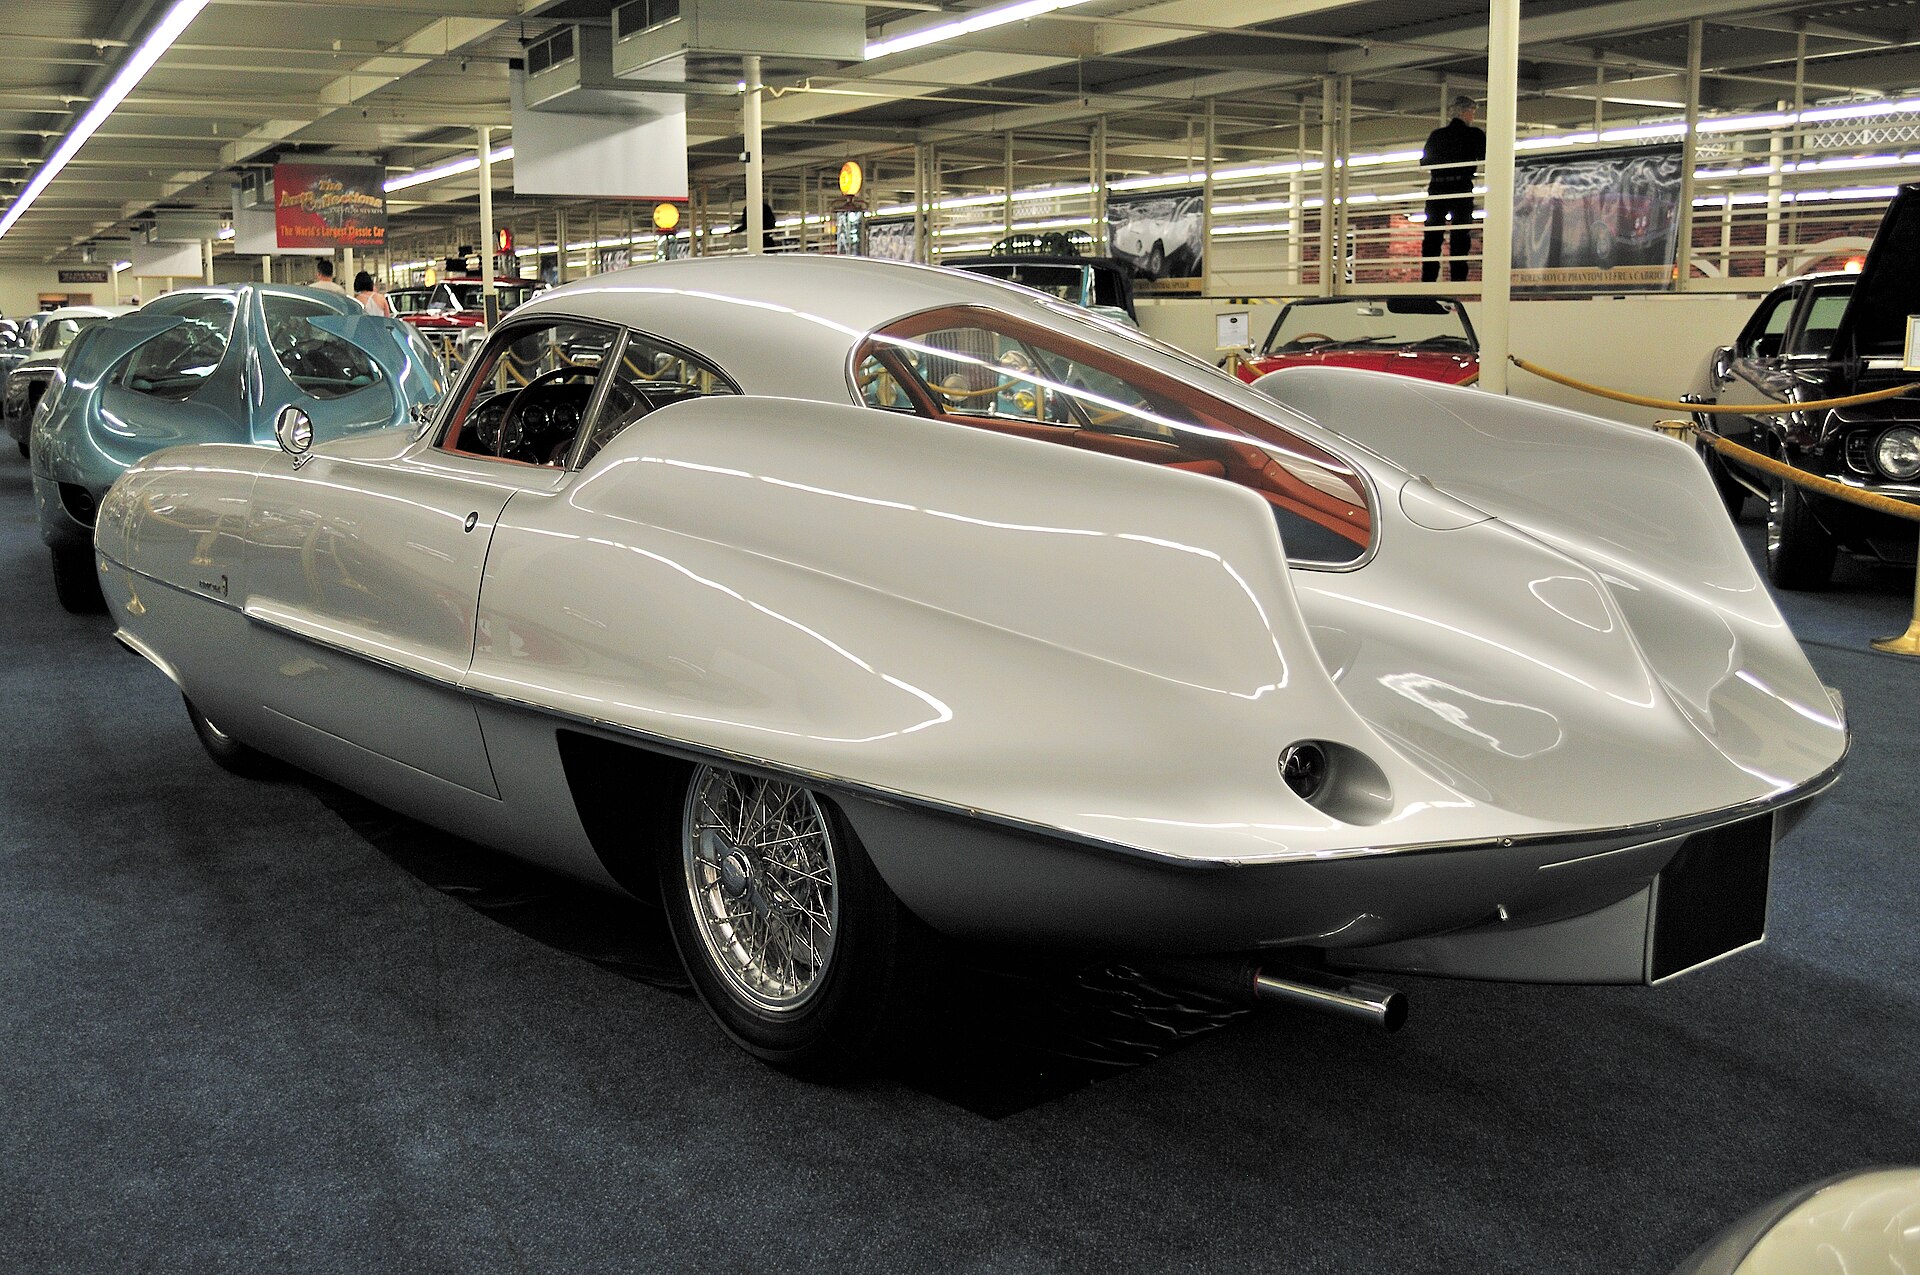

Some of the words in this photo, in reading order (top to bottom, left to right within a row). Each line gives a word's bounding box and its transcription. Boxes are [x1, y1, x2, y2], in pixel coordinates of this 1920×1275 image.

[318, 180, 343, 191] The
[280, 225, 293, 236] The
[295, 225, 320, 237] World's
[321, 226, 347, 239] Largest
[348, 225, 372, 237] Classic
[373, 225, 385, 237] Car
[1520, 272, 1566, 283] ROLLS-ROYCE
[1567, 271, 1603, 282] PHANTOM
